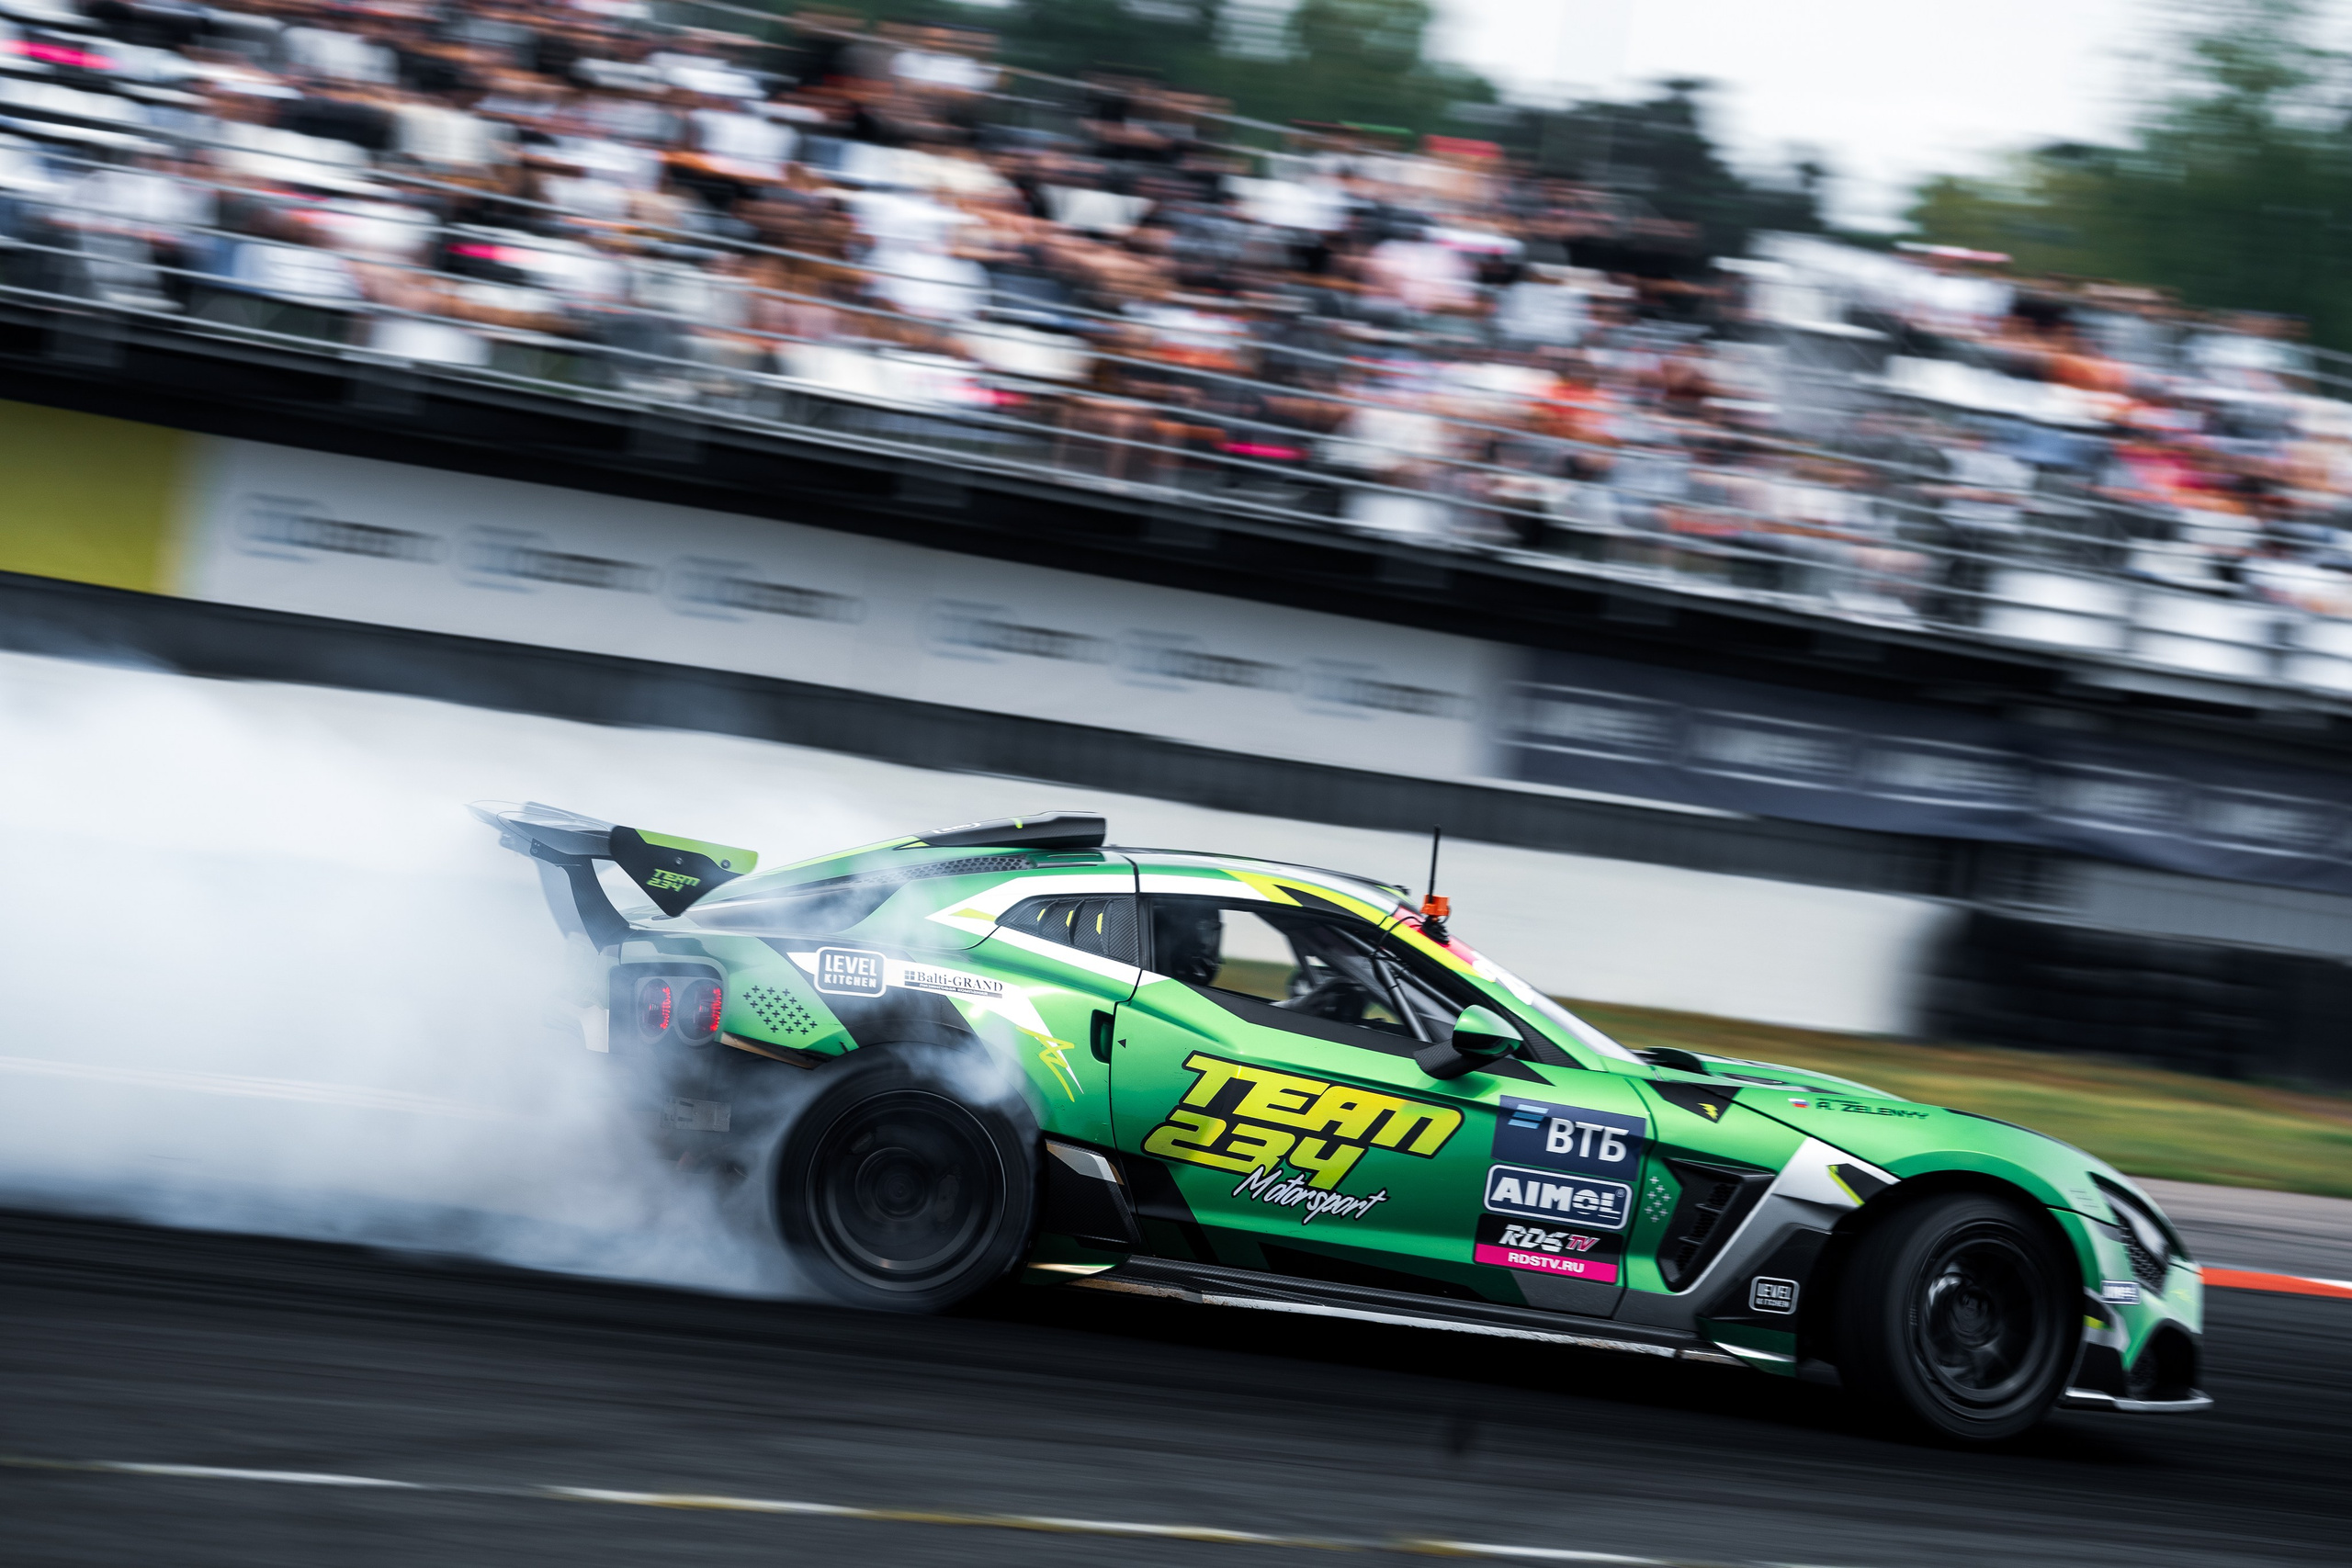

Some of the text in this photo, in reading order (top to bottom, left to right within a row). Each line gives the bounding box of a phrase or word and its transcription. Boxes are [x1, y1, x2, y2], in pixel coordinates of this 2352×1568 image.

[646, 877, 684, 892] 234
[654, 868, 701, 887] TEAM
[825, 953, 877, 976] LEVEL
[823, 973, 877, 988] KITCHEN
[917, 971, 1003, 992] Balti-GRAND
[1182, 1054, 1463, 1156] TEAM
[1143, 1109, 1366, 1191] 234
[1545, 1117, 1630, 1163] ВТБ
[1232, 1165, 1388, 1225] Motorsport
[1490, 1177, 1622, 1220] AIMOL
[1508, 1252, 1585, 1274] RDSTV.RU
[1757, 1282, 1792, 1300] LEVEL
